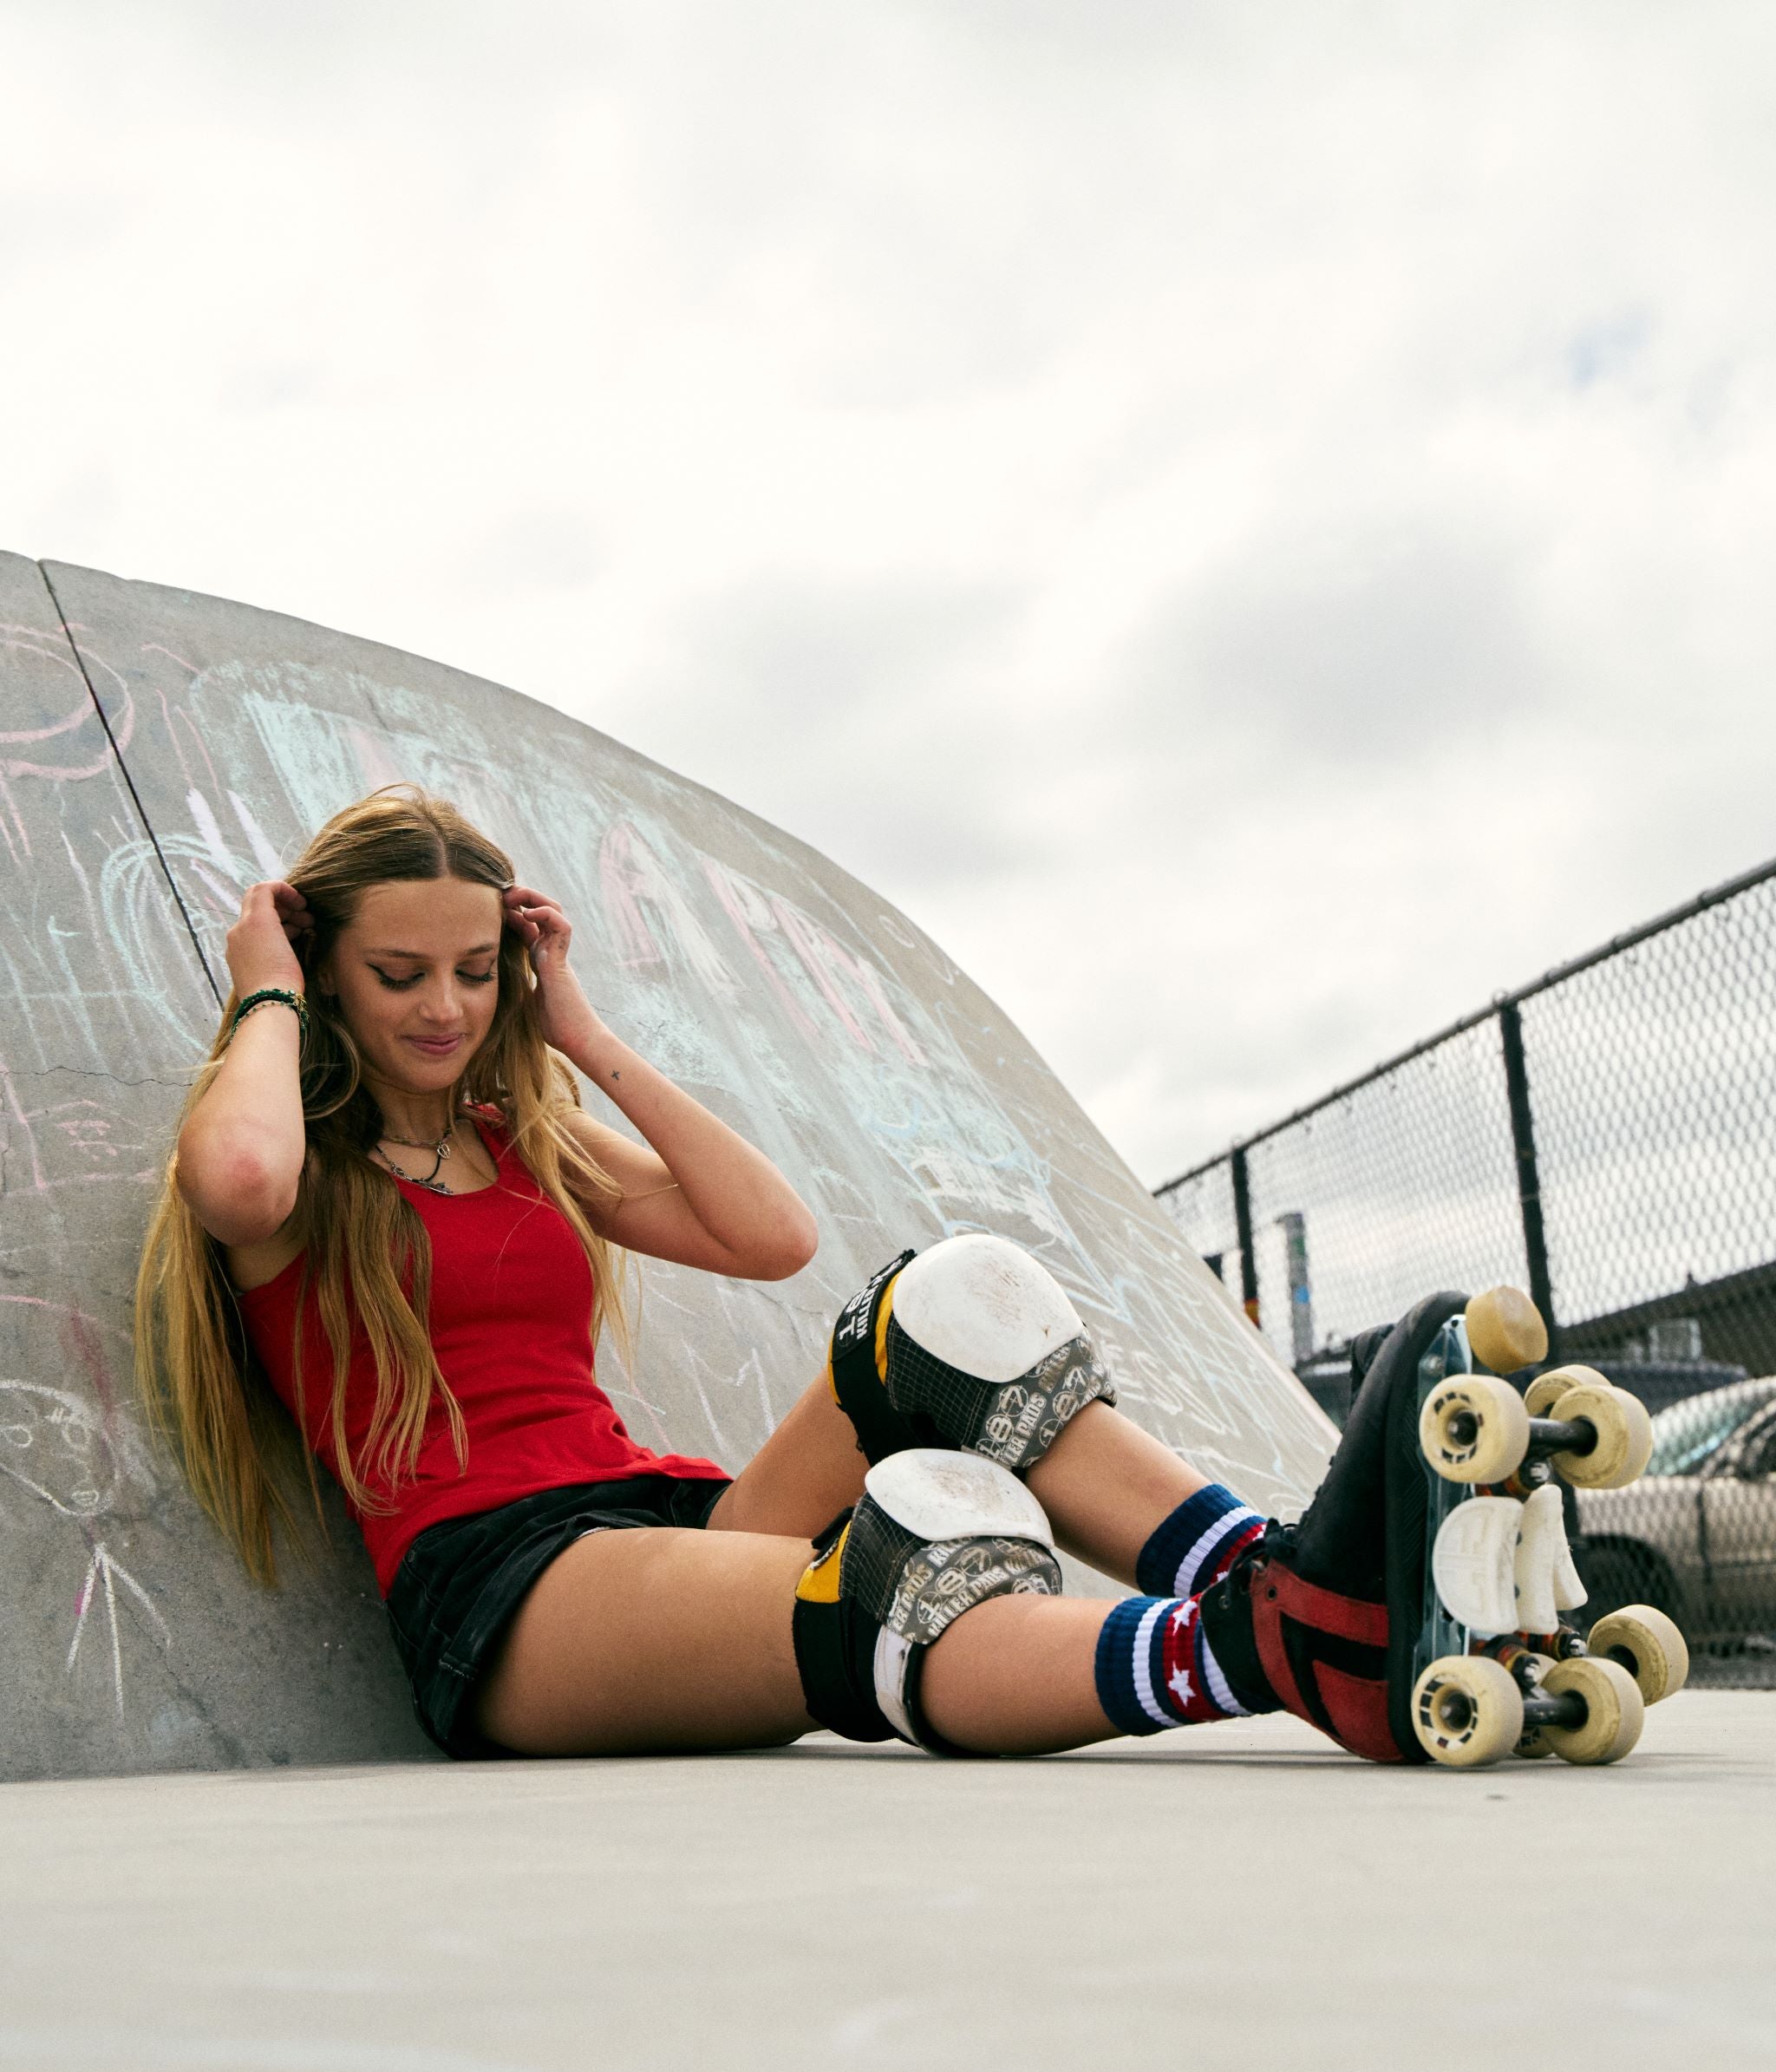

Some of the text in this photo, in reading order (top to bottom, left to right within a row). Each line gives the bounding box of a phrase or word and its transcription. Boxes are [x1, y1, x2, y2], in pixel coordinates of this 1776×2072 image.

[1016, 1391, 1047, 1437] PADS
[902, 1562, 934, 1611] PADS
[916, 1546, 992, 1624] 187
[927, 1565, 1010, 1637] KILLER PADS
